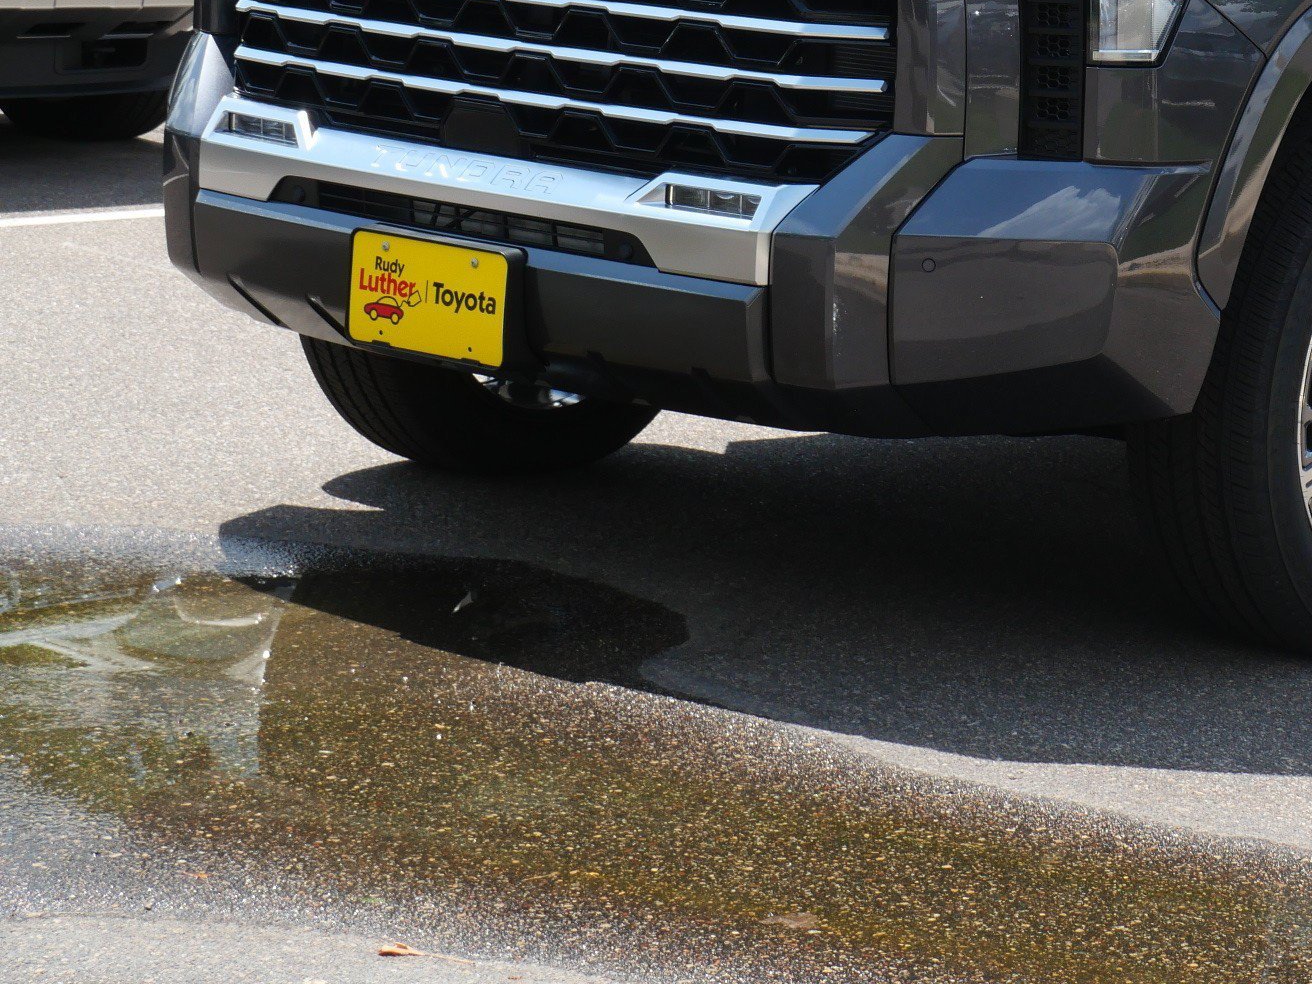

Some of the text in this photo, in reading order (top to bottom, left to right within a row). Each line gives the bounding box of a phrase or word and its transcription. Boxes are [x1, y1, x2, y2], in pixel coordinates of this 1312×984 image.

[371, 144, 564, 195] TUNDRA
[375, 256, 405, 277] Rudy
[359, 268, 497, 315] Luther Toyota
